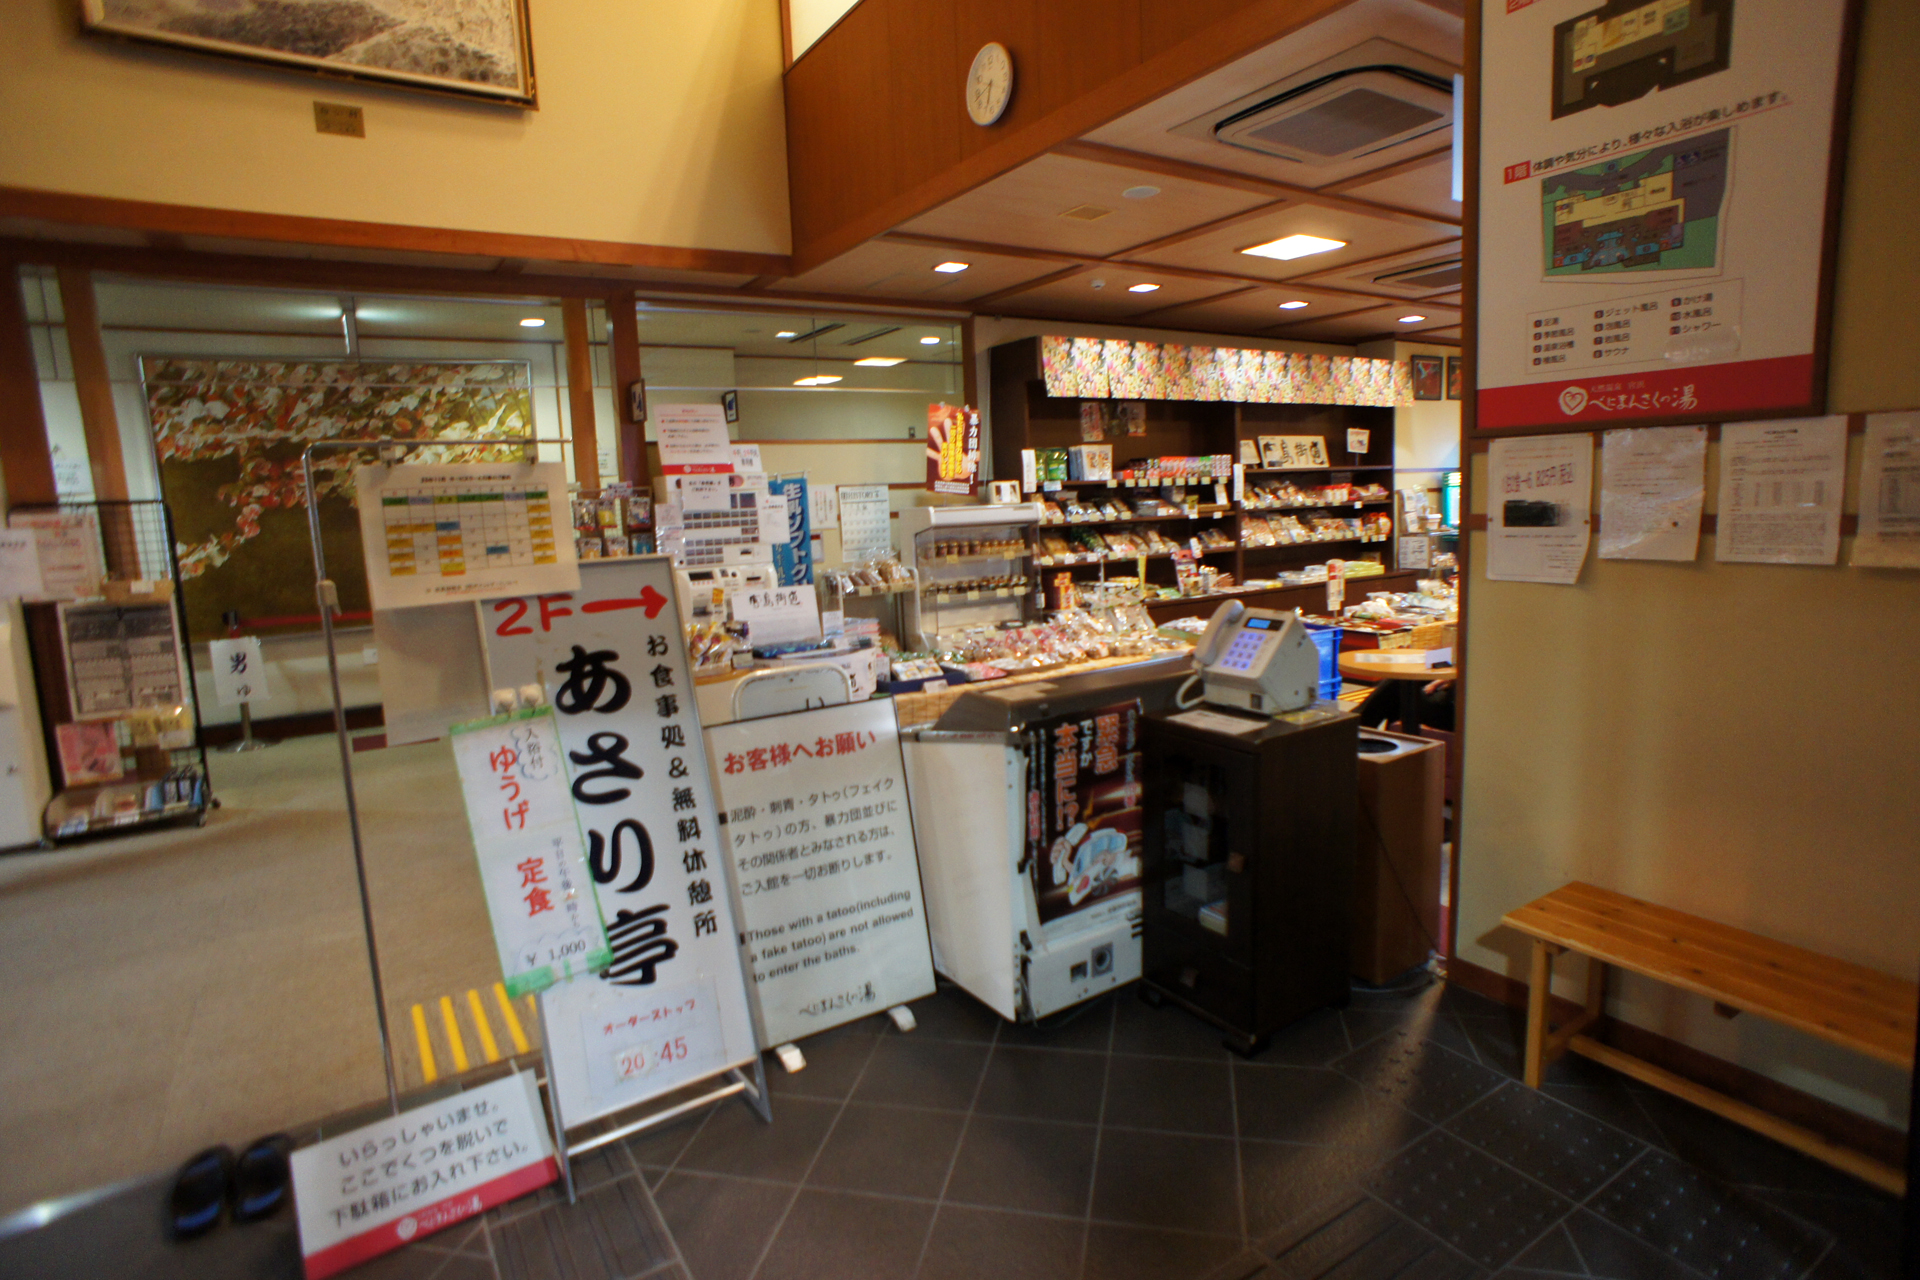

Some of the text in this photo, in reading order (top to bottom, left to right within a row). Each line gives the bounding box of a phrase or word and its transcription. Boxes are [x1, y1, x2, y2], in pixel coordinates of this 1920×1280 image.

[1682, 322, 1721, 334] シャワー
[1589, 384, 1698, 411] べにまんさくの湯
[494, 594, 573, 637] 2F
[724, 730, 876, 775] お客様へお願い
[490, 746, 529, 830] ゆうげ
[647, 635, 718, 938] お食事処&無料休憩所
[555, 645, 679, 986] あさり亭
[517, 857, 554, 917] 定食
[549, 939, 586, 960] 1,000
[748, 923, 785, 942] Those
[789, 915, 813, 931] with
[816, 915, 824, 923] a
[751, 908, 913, 963] a fake tatoo) are not allowed
[753, 945, 860, 983] to enter the baths.
[340, 1100, 499, 1168] いらっしゃいませ。
[341, 1118, 508, 1195] ここでくつを脱いで
[331, 1142, 529, 1228] 下駄箱にお入れ下さい。
